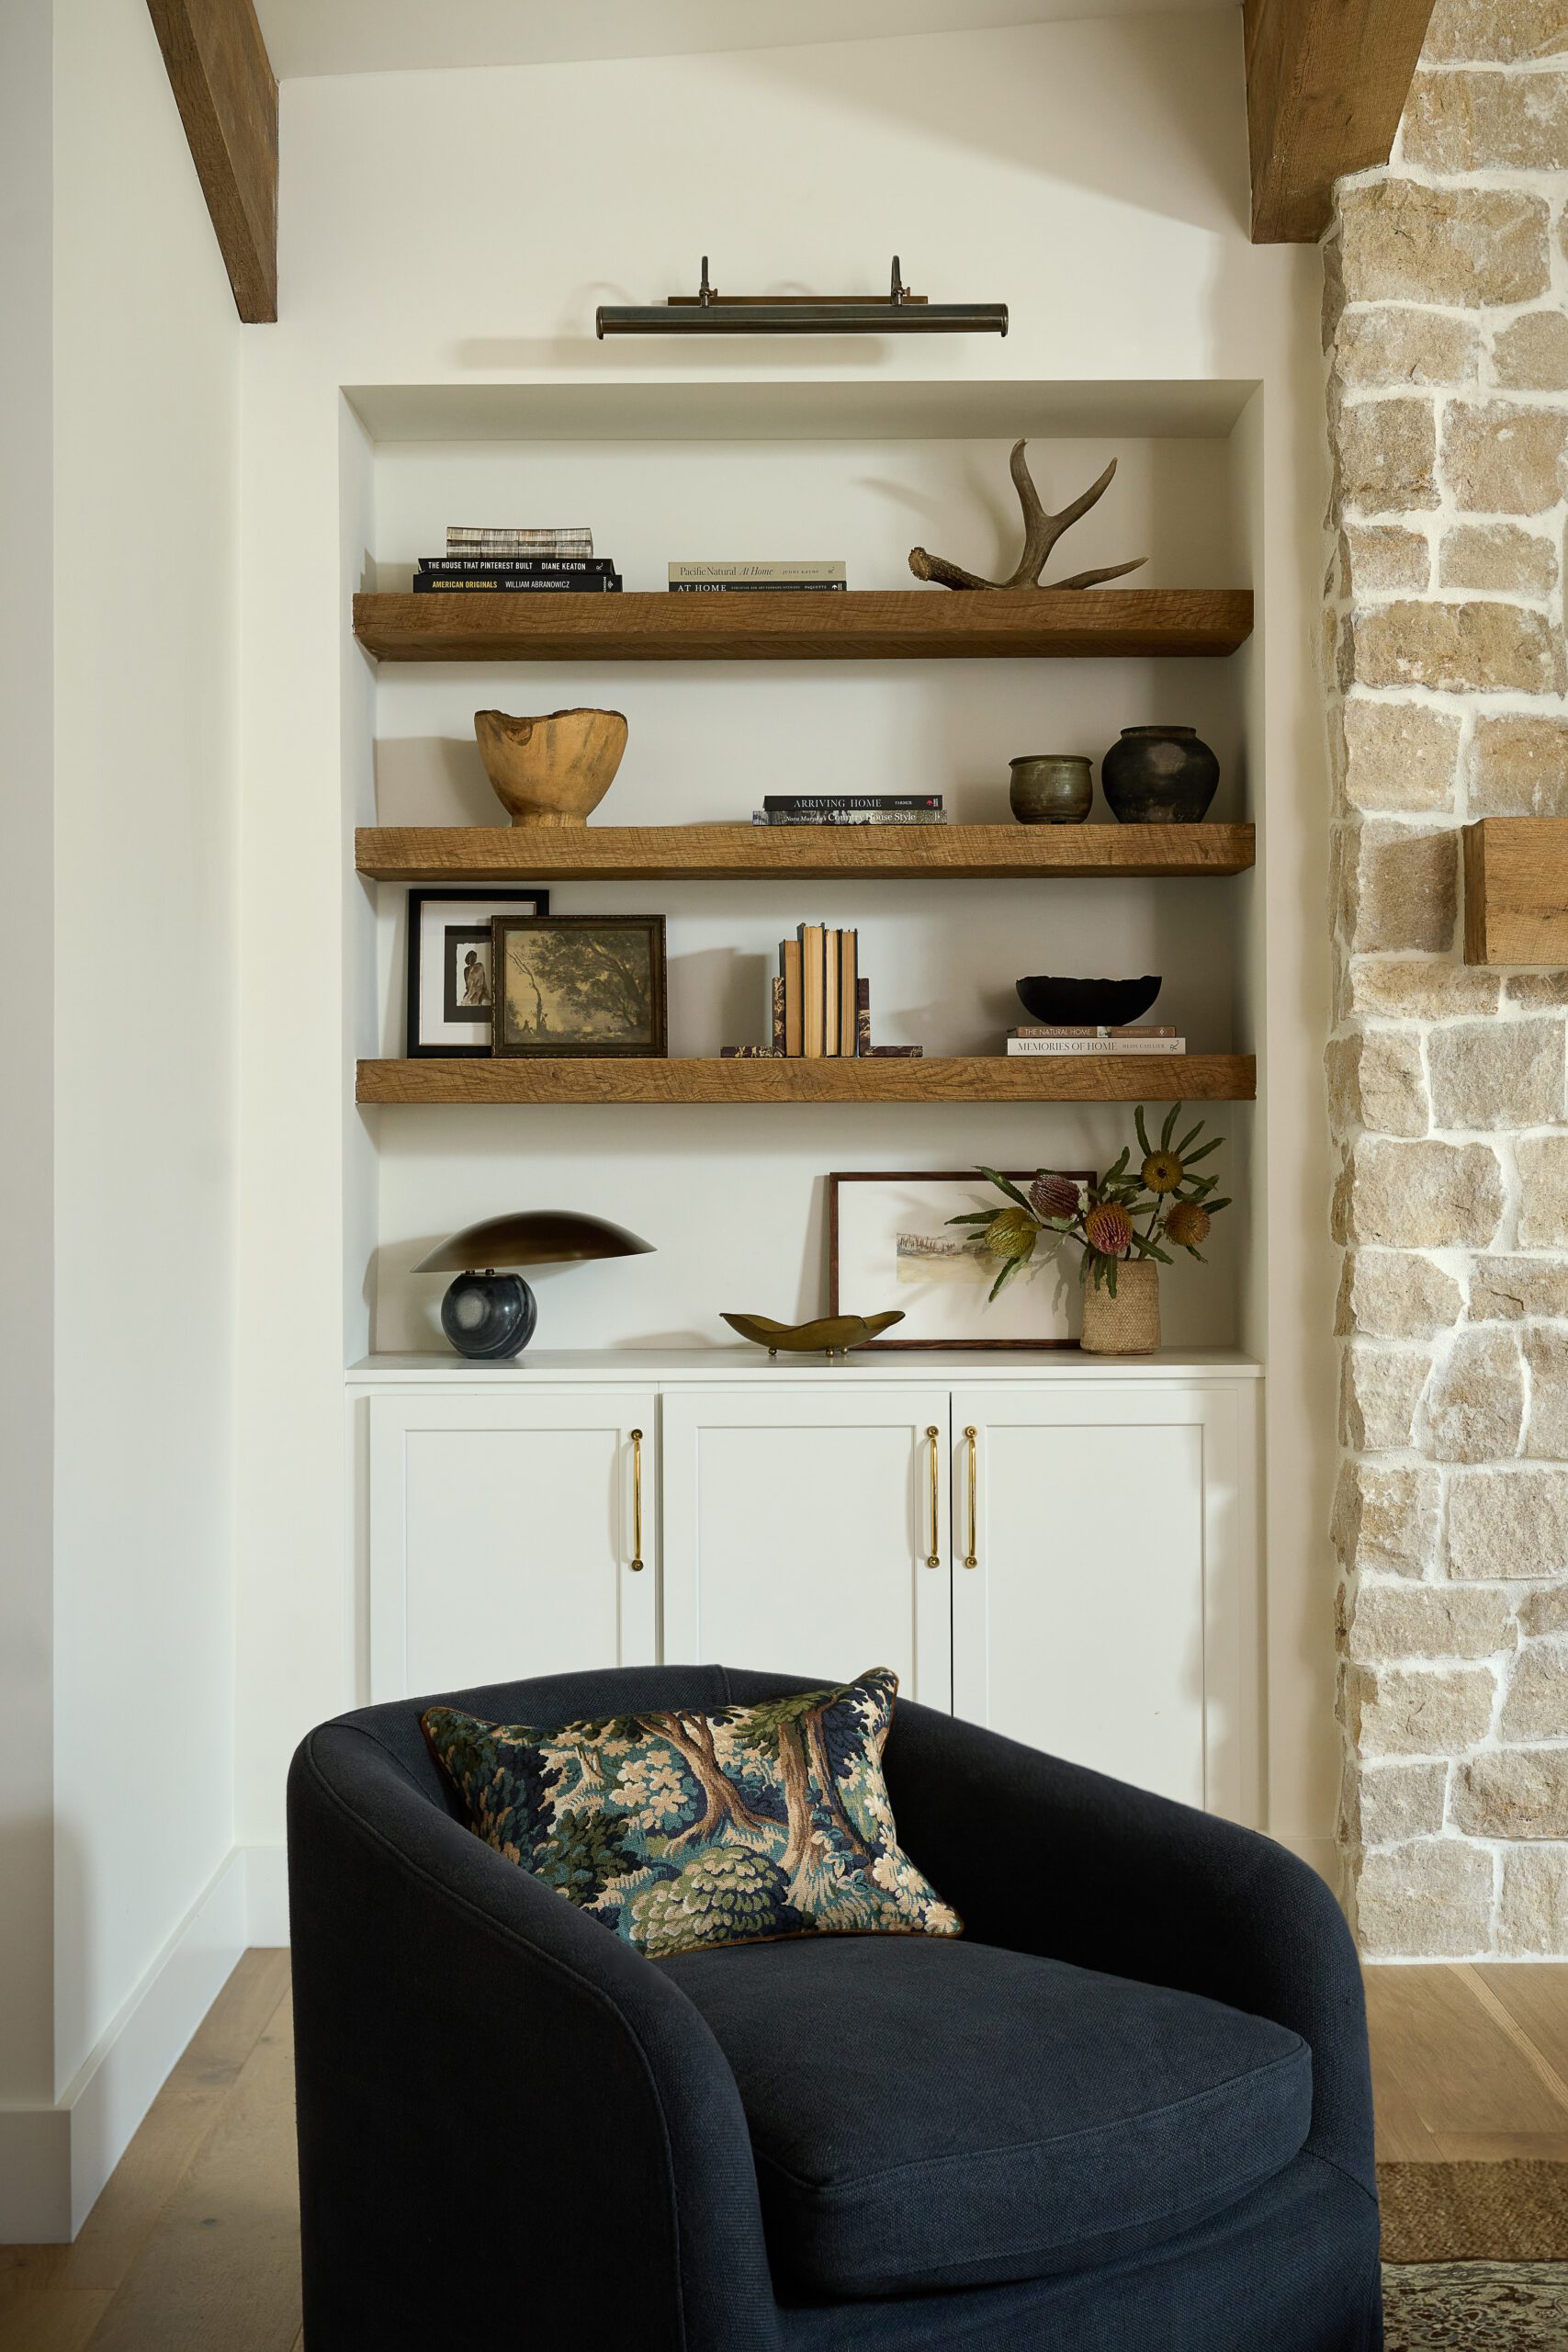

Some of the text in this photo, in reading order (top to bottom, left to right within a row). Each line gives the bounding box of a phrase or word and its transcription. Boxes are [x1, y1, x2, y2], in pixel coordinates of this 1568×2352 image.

[441, 561, 461, 570] HOUSE
[464, 561, 479, 570] THAT
[480, 561, 513, 570] PINTEREST
[680, 566, 773, 576] Pacific Natural At Home
[794, 798, 882, 808] ARRIVING HOME
[828, 812, 863, 822] Country
[865, 812, 893, 821] House
[894, 812, 917, 822] Style
[1018, 1042, 1118, 1051] MEMORIES OF HOME
